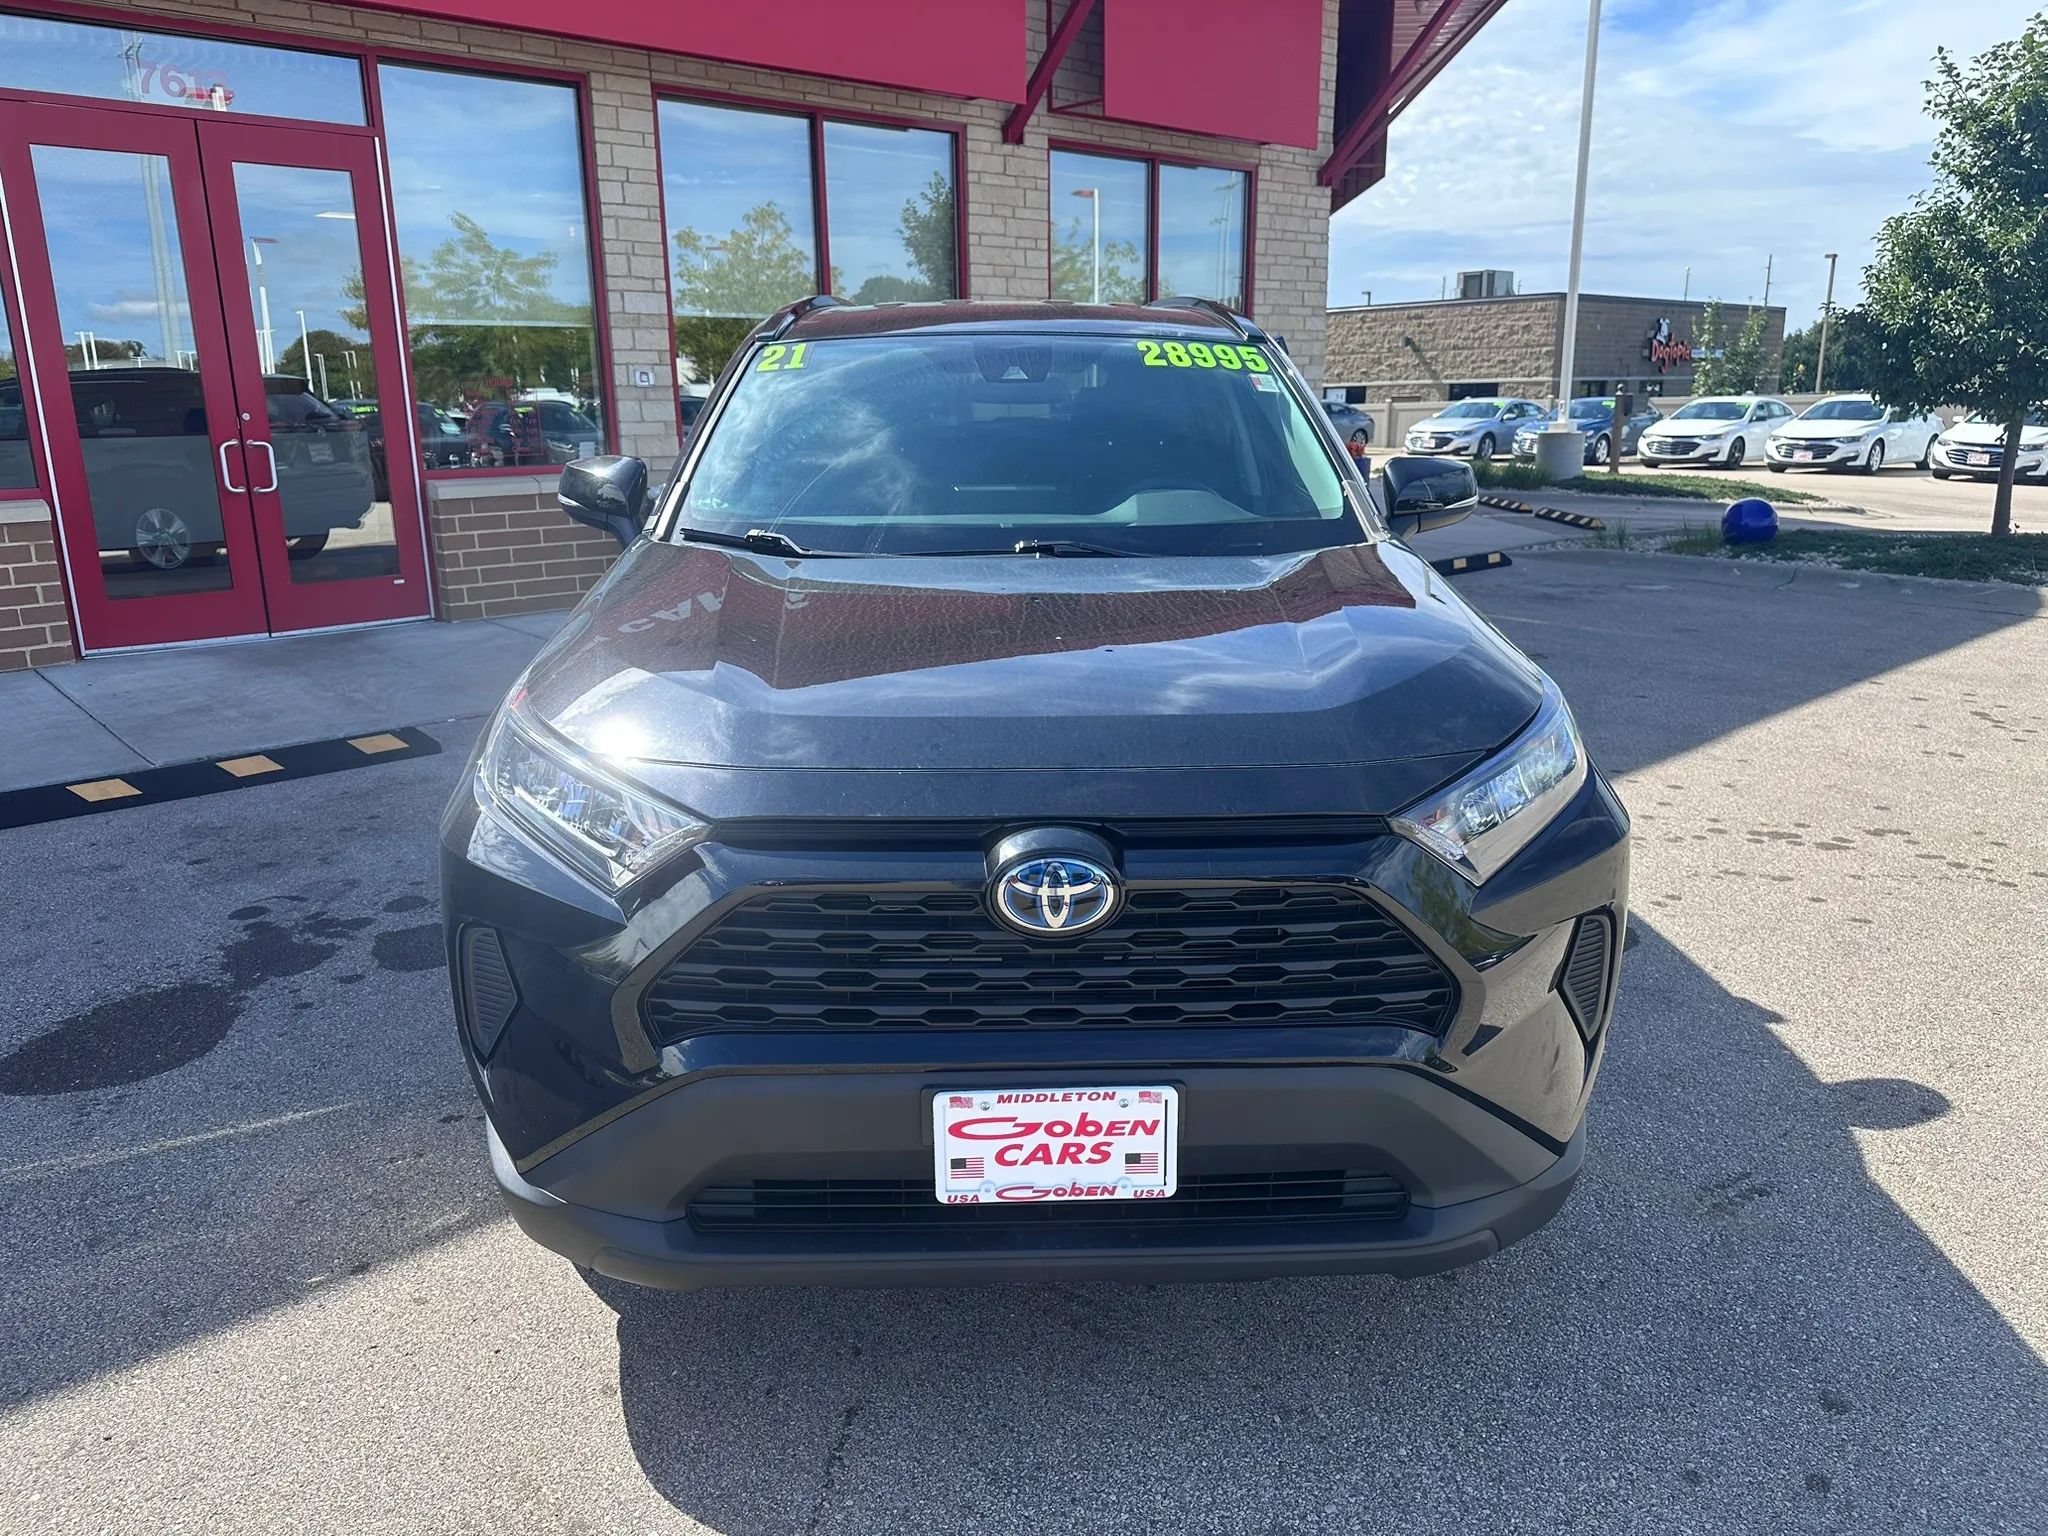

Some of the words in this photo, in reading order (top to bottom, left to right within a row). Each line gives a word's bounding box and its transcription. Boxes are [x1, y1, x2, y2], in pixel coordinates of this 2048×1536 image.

[756, 343, 807, 372] 21
[1137, 340, 1269, 372] 28995
[997, 1091, 1117, 1104] MIDDLETON
[994, 1141, 1114, 1167] CARS
[947, 1194, 980, 1204] USA
[1133, 1189, 1166, 1199] USA
